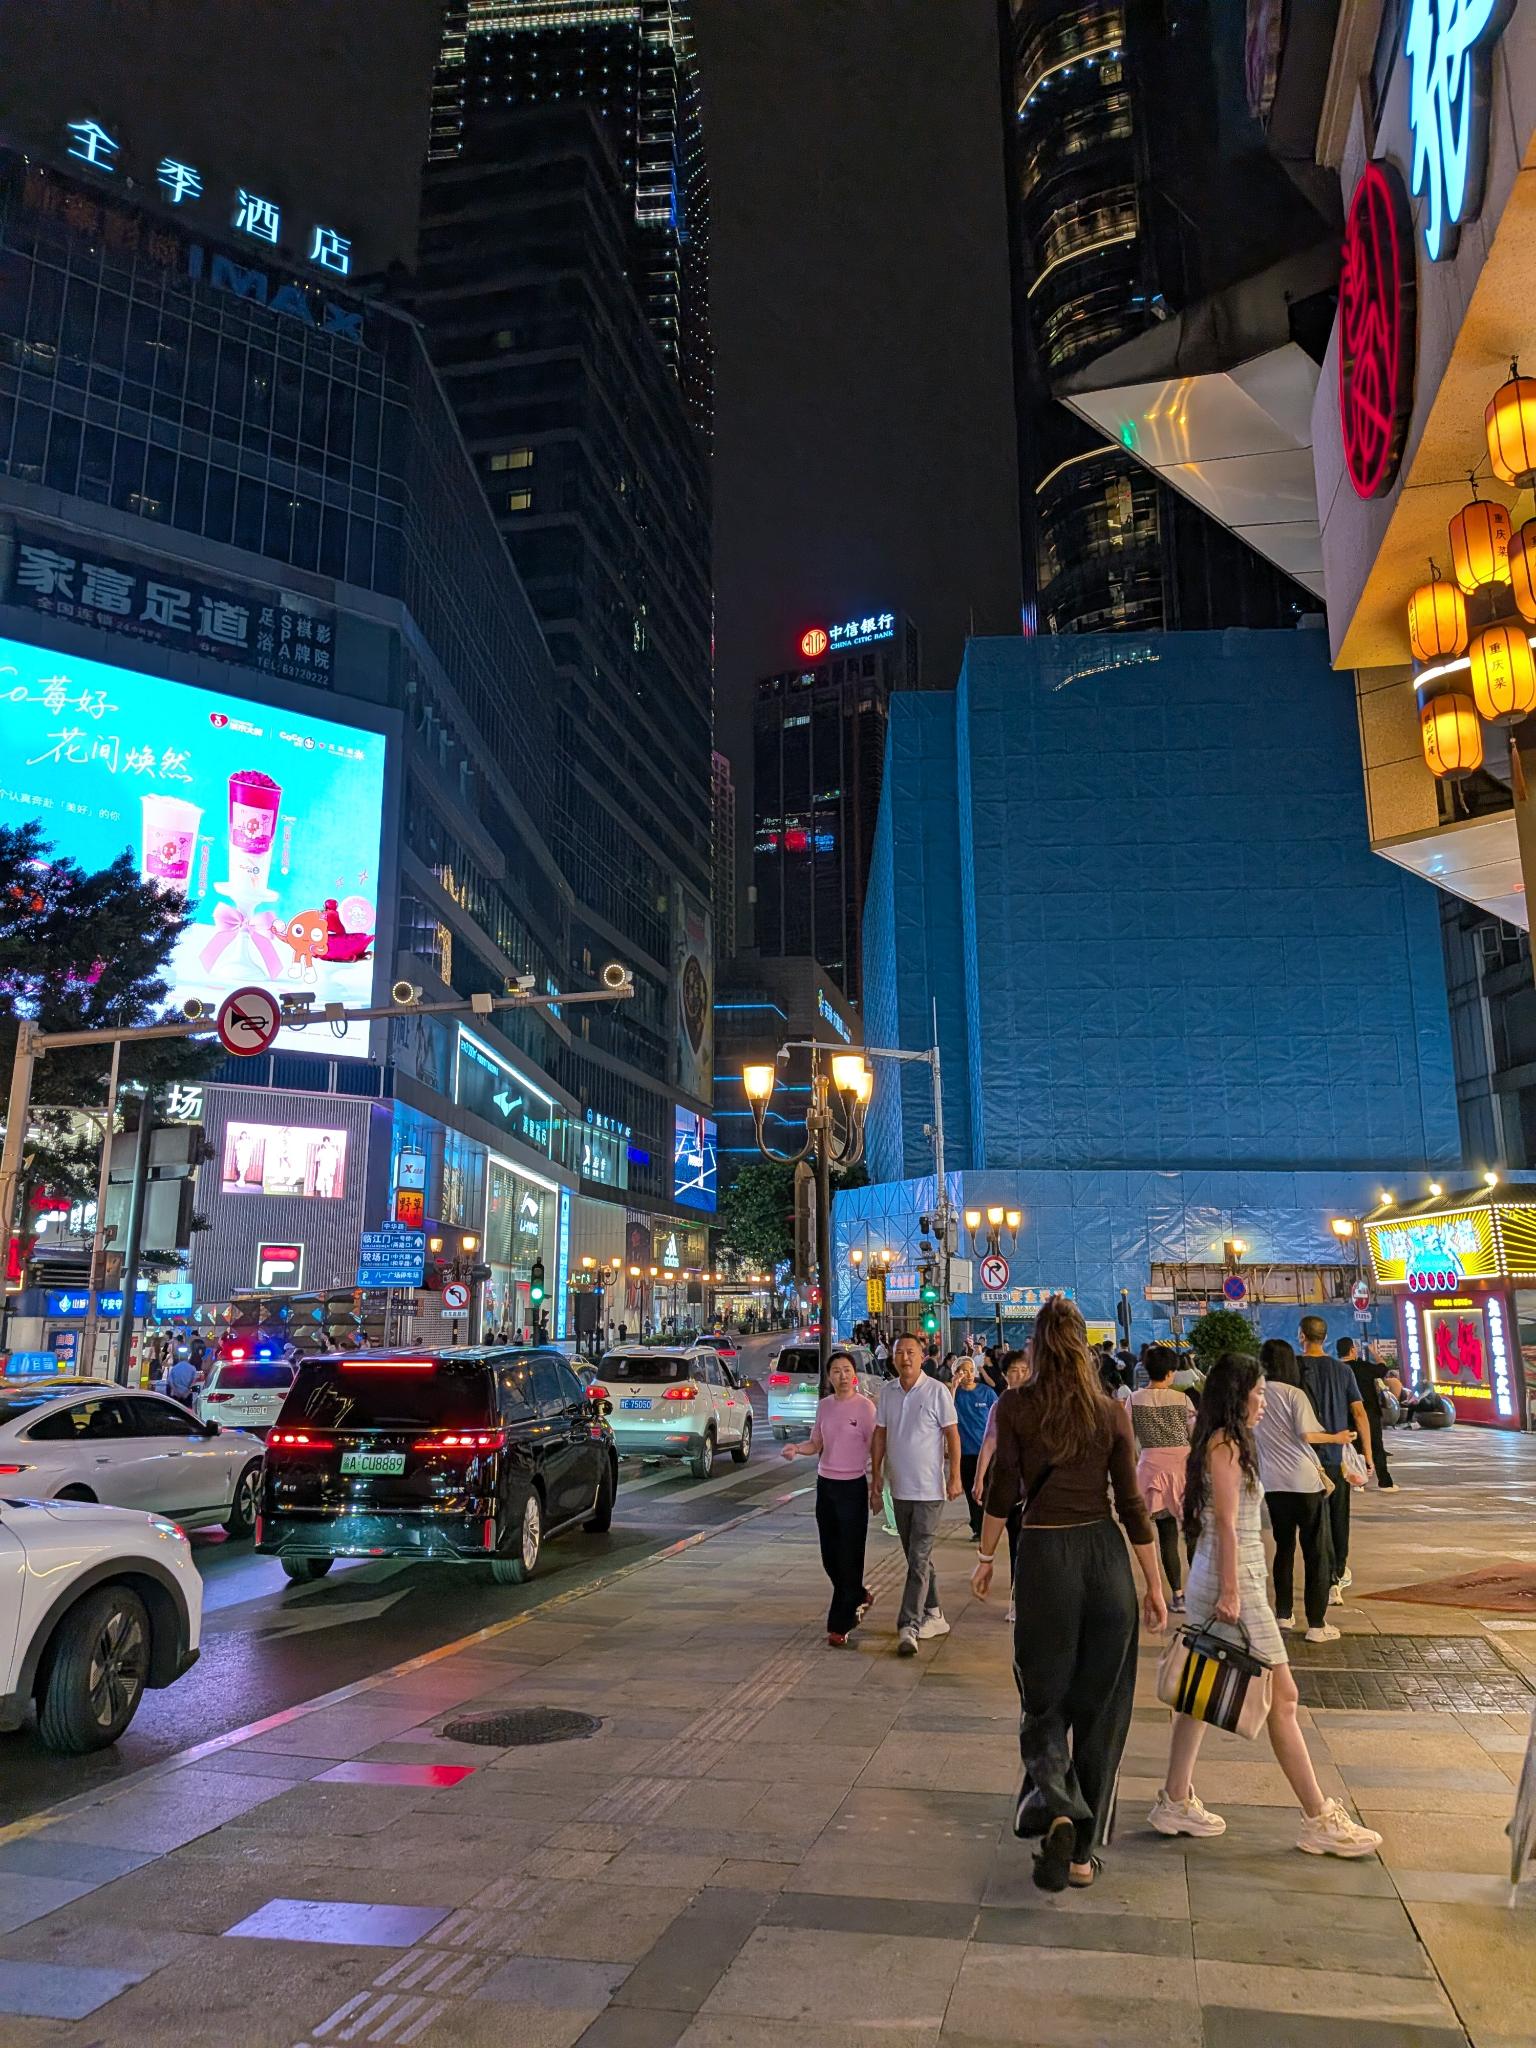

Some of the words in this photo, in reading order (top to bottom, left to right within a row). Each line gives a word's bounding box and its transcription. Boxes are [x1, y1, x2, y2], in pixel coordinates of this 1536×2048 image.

[67, 119, 353, 276] 全季酒店
[188, 245, 365, 347] IMAX
[1494, 512, 1508, 558] 重庆菜
[16, 544, 251, 650] 家富足道
[256, 607, 276, 653] 足浴
[278, 614, 293, 659] SPA
[294, 617, 313, 664] 棋牌
[314, 624, 331, 671] 影院
[829, 613, 895, 642] 中信银行
[830, 639, 852, 650] CHINA
[854, 634, 873, 645] CITIC
[874, 630, 894, 640] BANK
[1489, 642, 1507, 690] 重庆菜
[26, 727, 193, 783] 花间焕然
[167, 1085, 204, 1119] 场
[362, 1252, 390, 1262] 较场口
[363, 1234, 391, 1244] 临江门
[1434, 1315, 1483, 1382] 火锅
